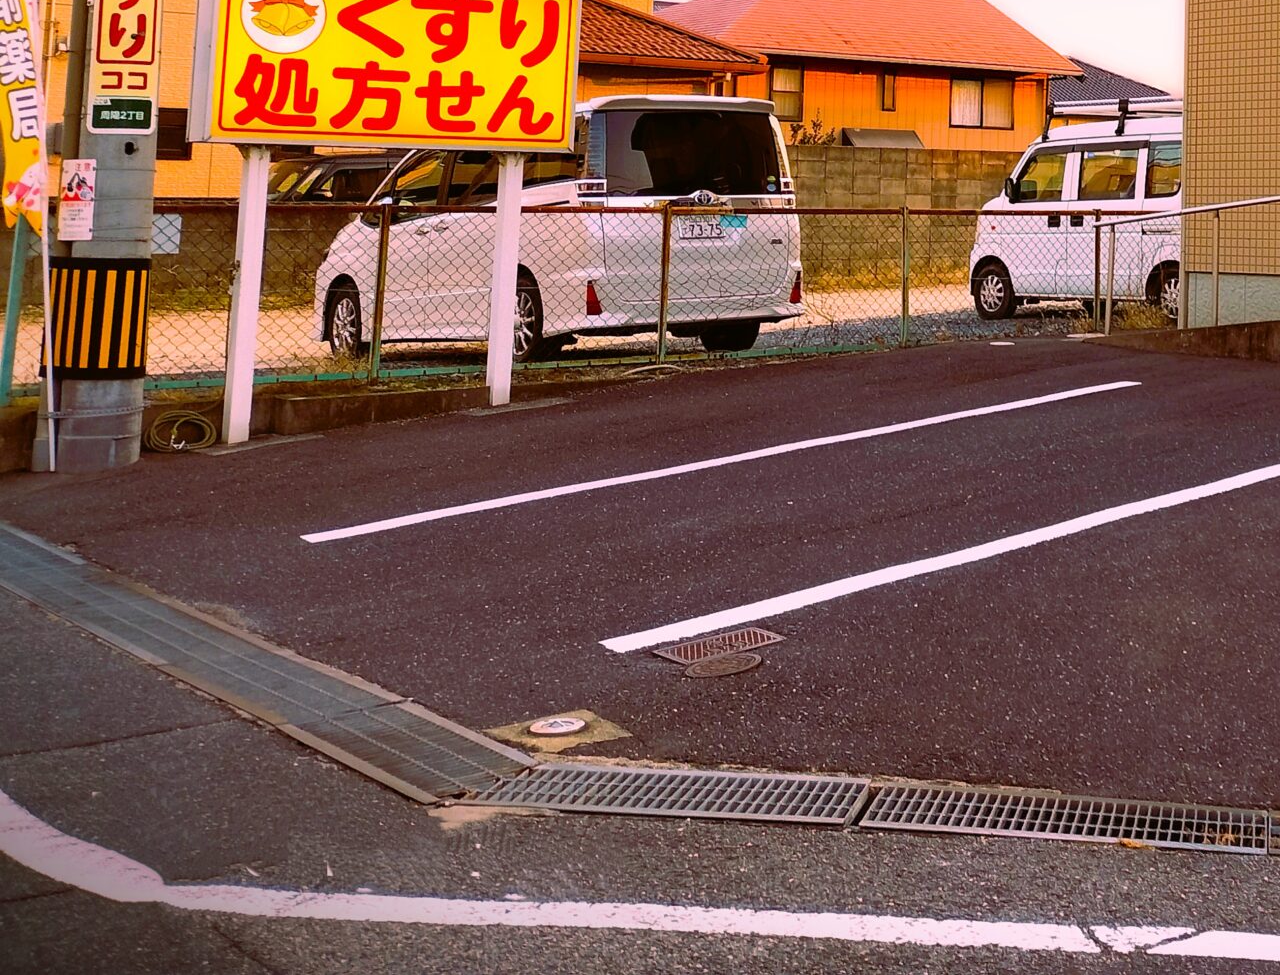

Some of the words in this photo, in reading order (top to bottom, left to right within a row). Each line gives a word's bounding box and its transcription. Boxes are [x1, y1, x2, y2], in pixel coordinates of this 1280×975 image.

[101, 71, 148, 90] ココ
[233, 53, 555, 136] 処方せん
